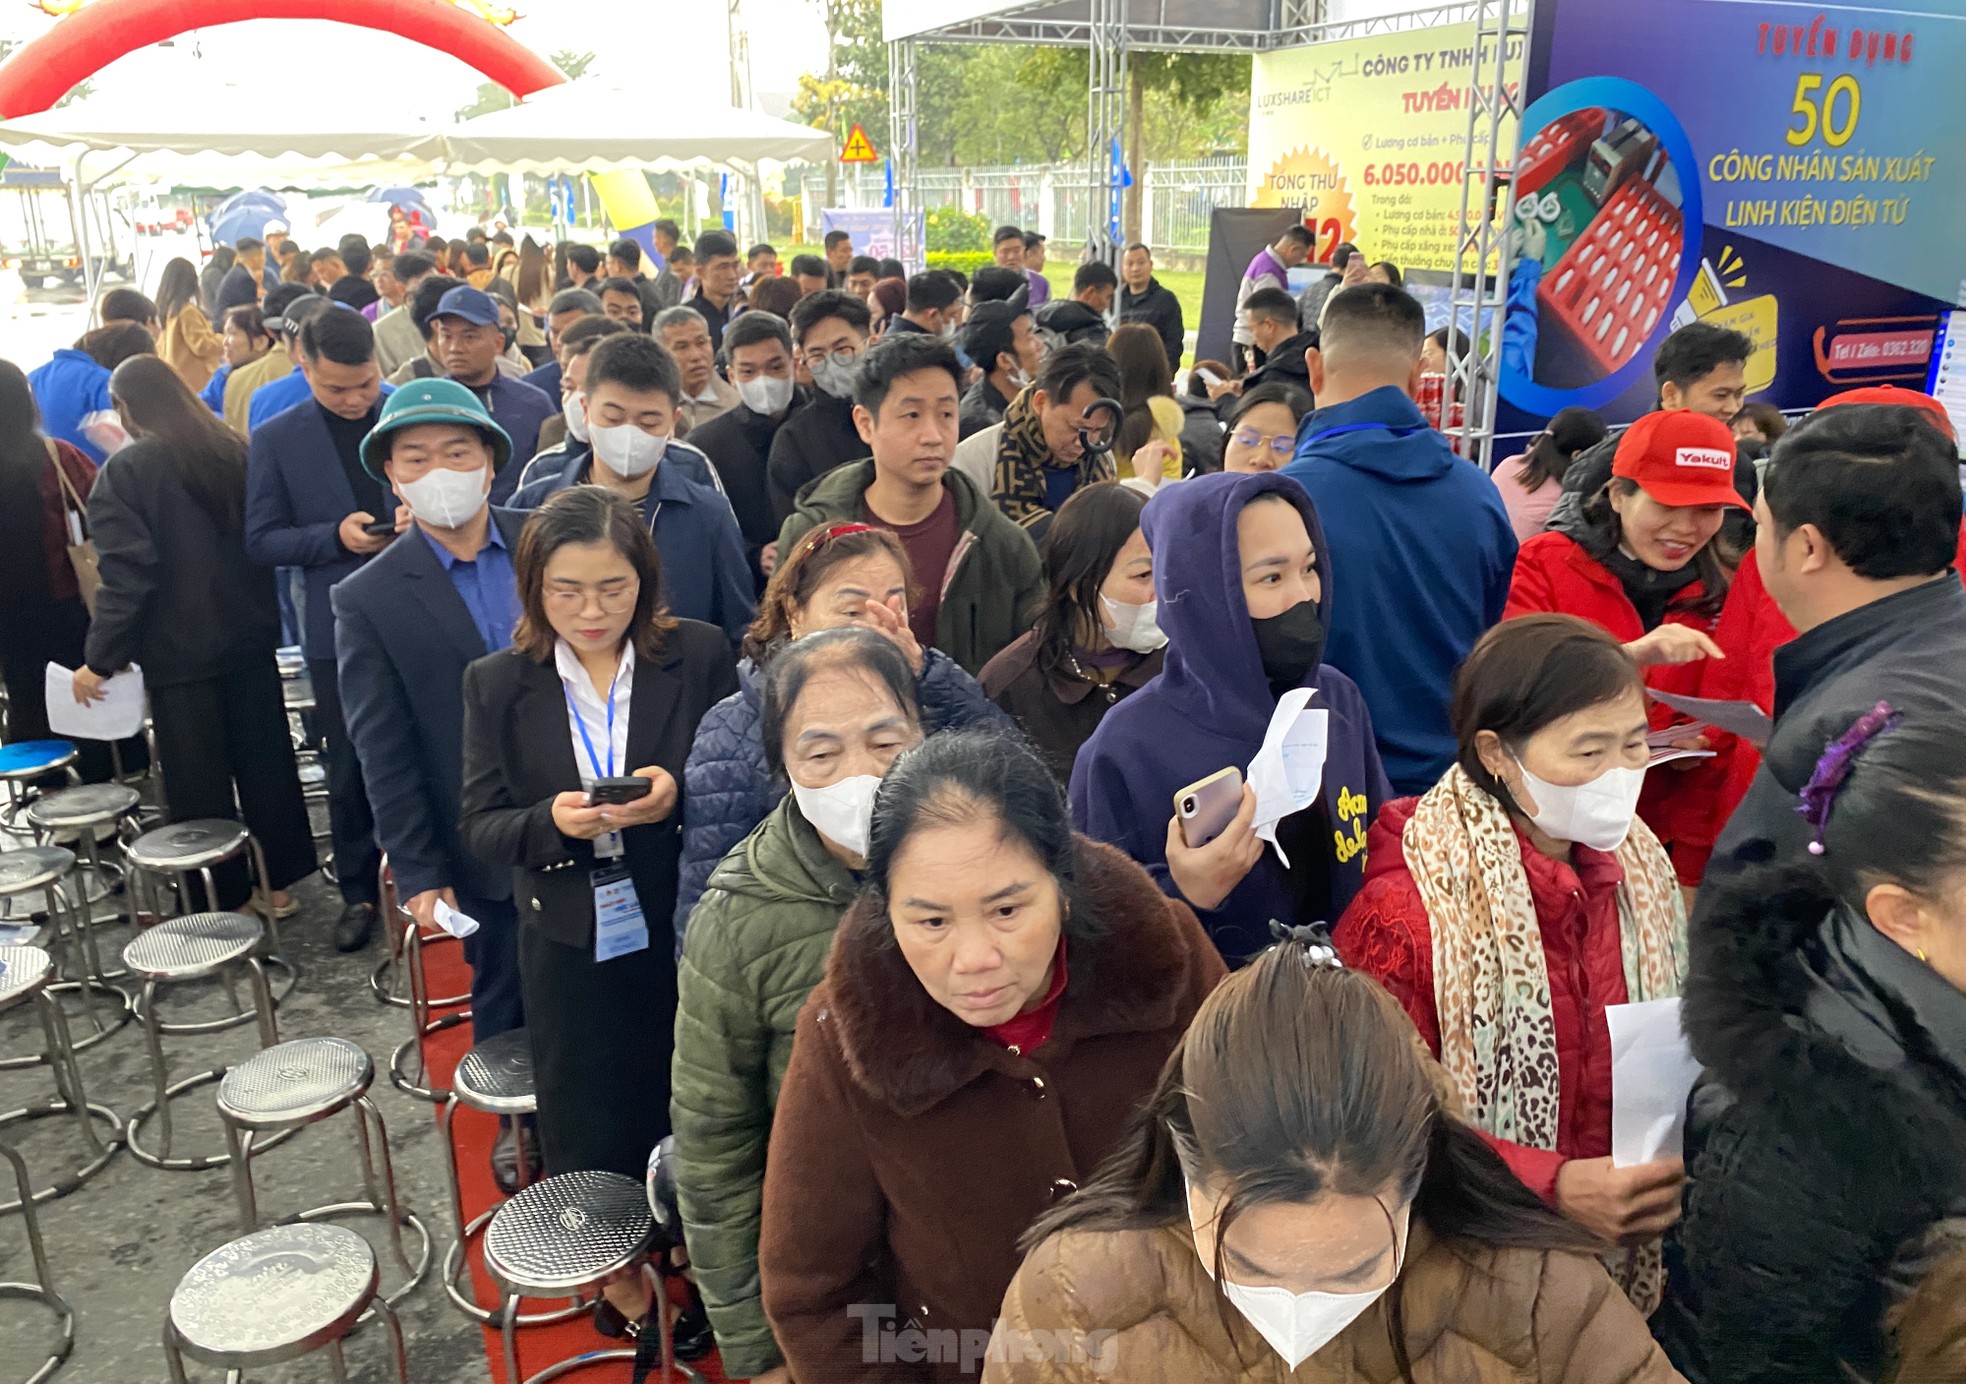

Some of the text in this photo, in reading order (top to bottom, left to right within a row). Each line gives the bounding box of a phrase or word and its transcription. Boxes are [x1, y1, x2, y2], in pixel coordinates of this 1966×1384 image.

[1362, 53, 1409, 78] CÔNG
[1414, 53, 1435, 72] TY
[1440, 46, 1487, 68] TNHH
[1258, 88, 1311, 108] LUXSHARE
[1786, 72, 1862, 148] 50
[1363, 162, 1464, 186] 6.050.000
[1709, 148, 1773, 182] CÔNG
[1776, 149, 1837, 182] NHÂN
[1839, 148, 1880, 182] SẢN
[1310, 173, 1337, 189] THU
[1725, 200, 1777, 226] LINH
[1779, 194, 1826, 231] KIỆN
[1829, 194, 1878, 231] ĐIỆN
[1680, 453, 1729, 467] Yakult
